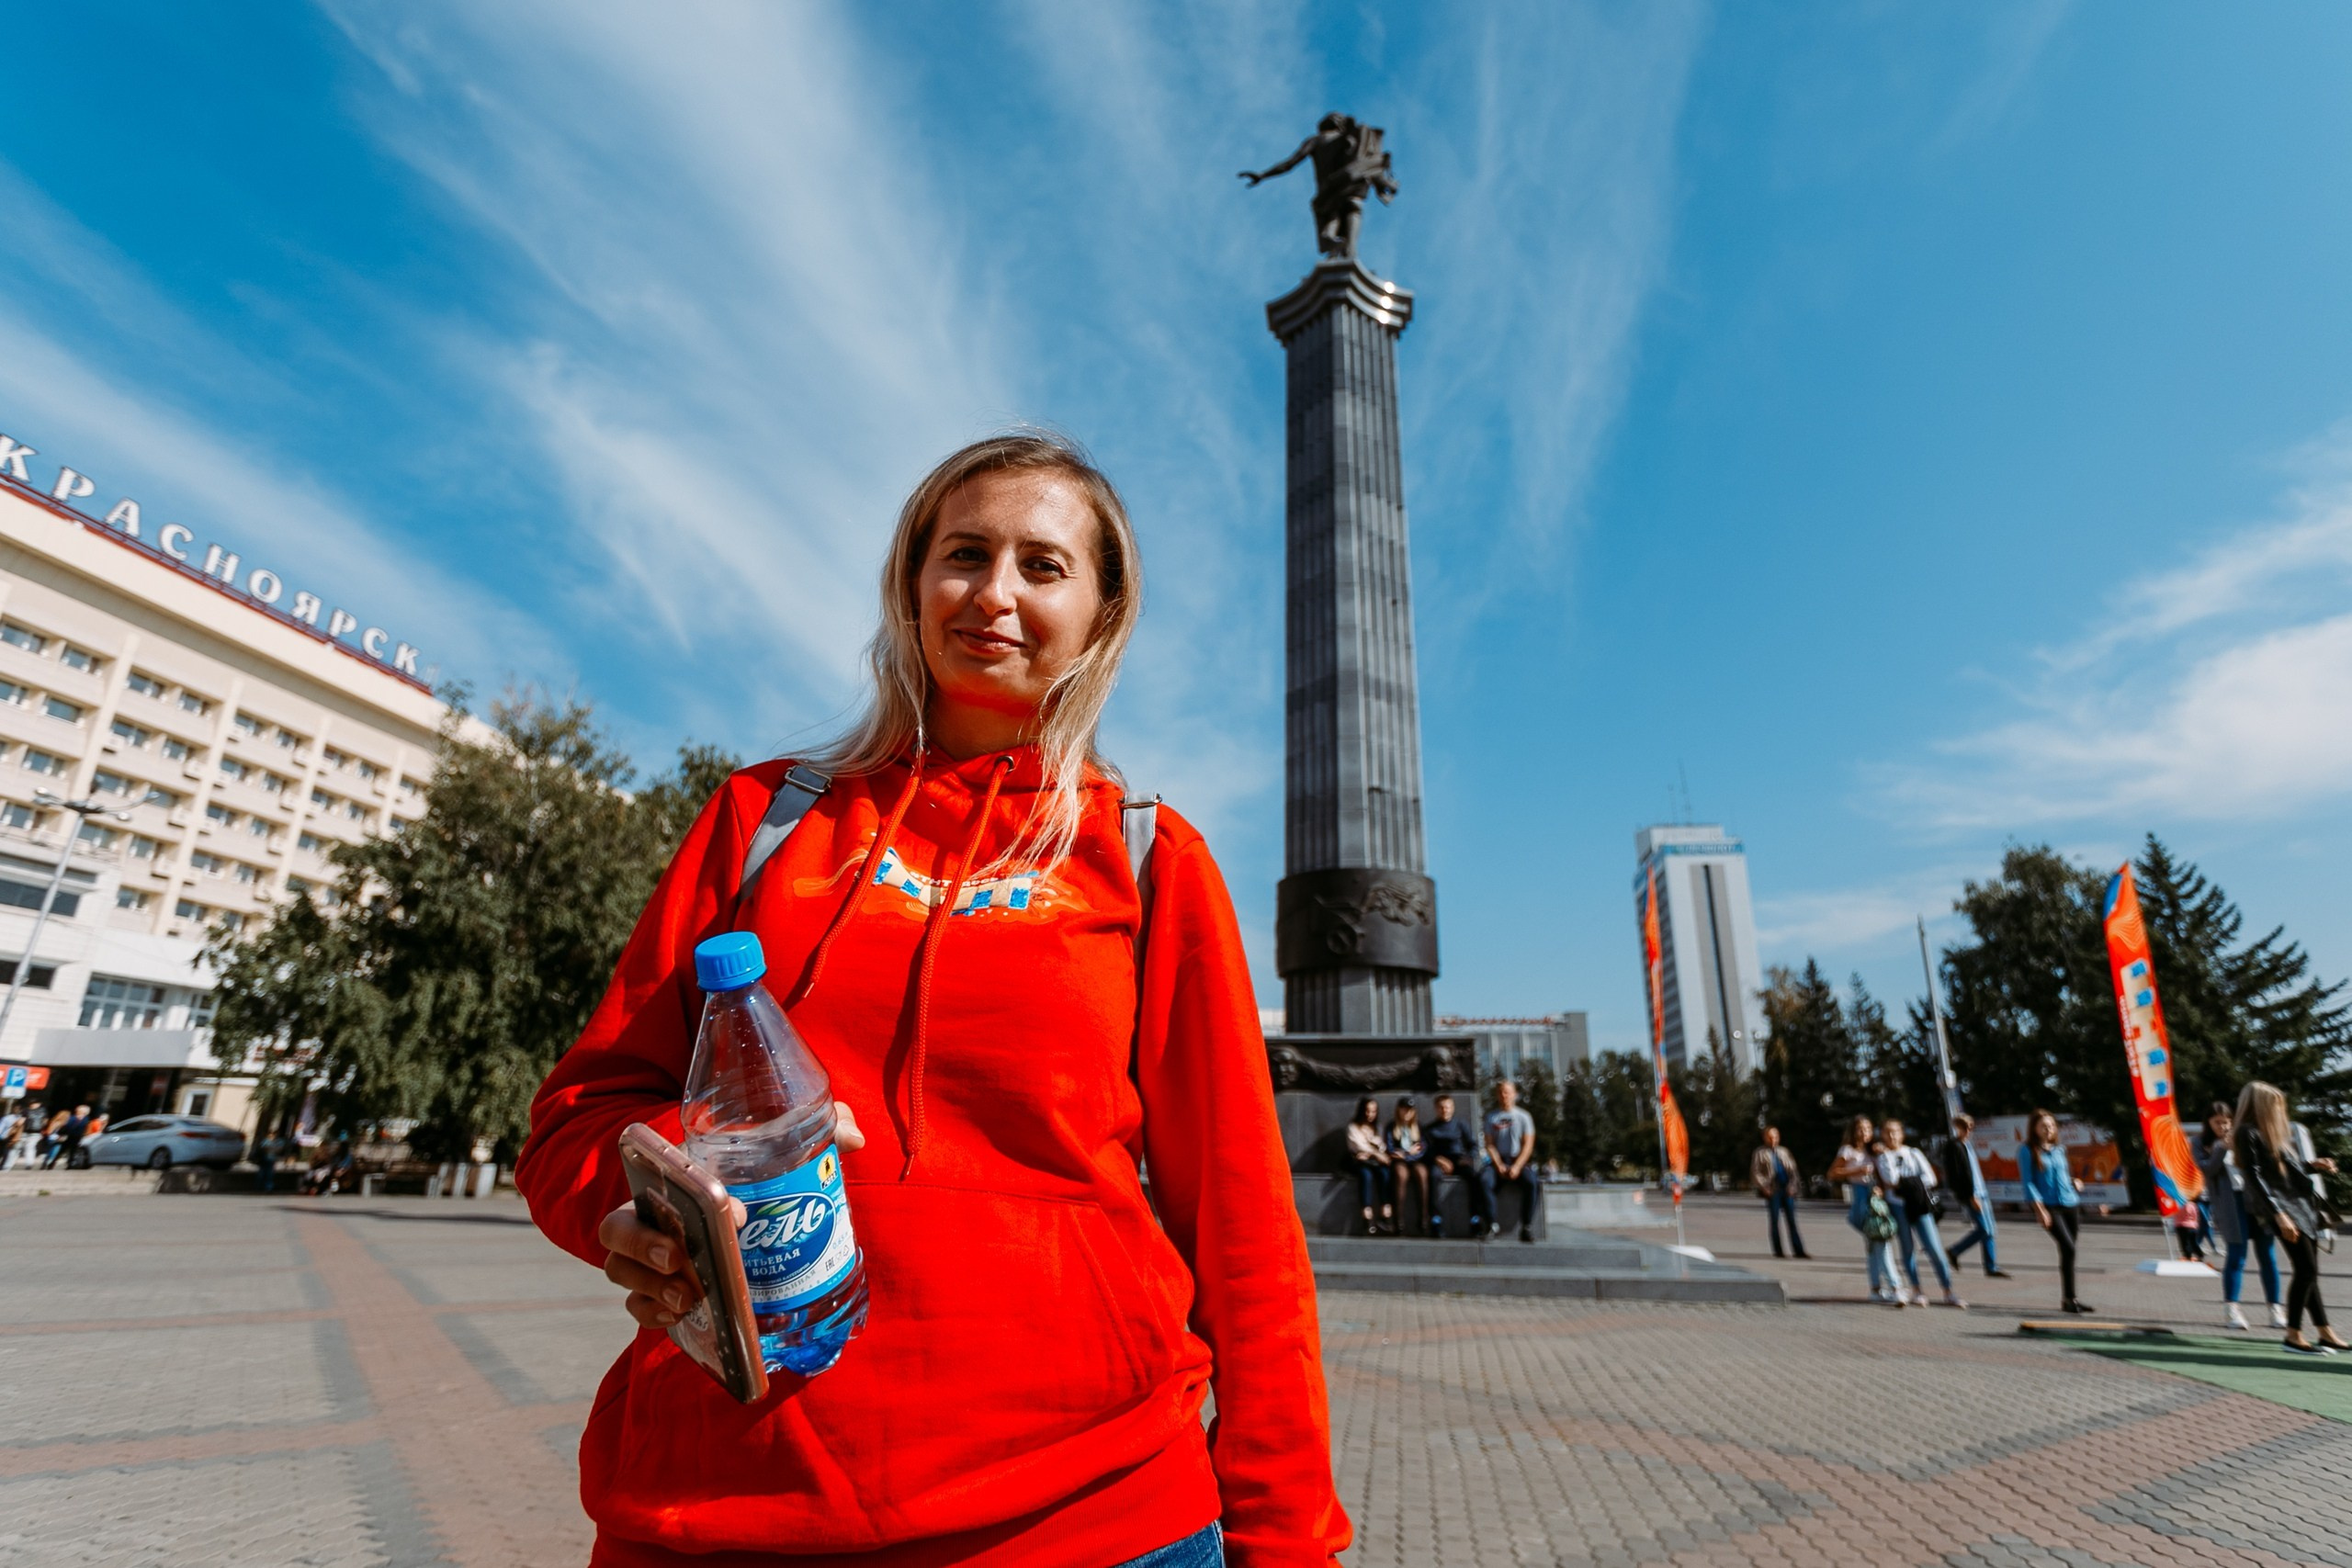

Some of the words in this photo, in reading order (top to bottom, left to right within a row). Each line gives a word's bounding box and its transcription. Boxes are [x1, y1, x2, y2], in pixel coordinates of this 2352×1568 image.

[0, 434, 422, 676] КРАСНОЯРСК
[739, 1197, 825, 1250] ель
[743, 1247, 801, 1268] ИТЬЕВАЯ
[752, 1263, 786, 1276] ВОДА
[749, 1269, 816, 1296] ЗИРОВАННАЯ
